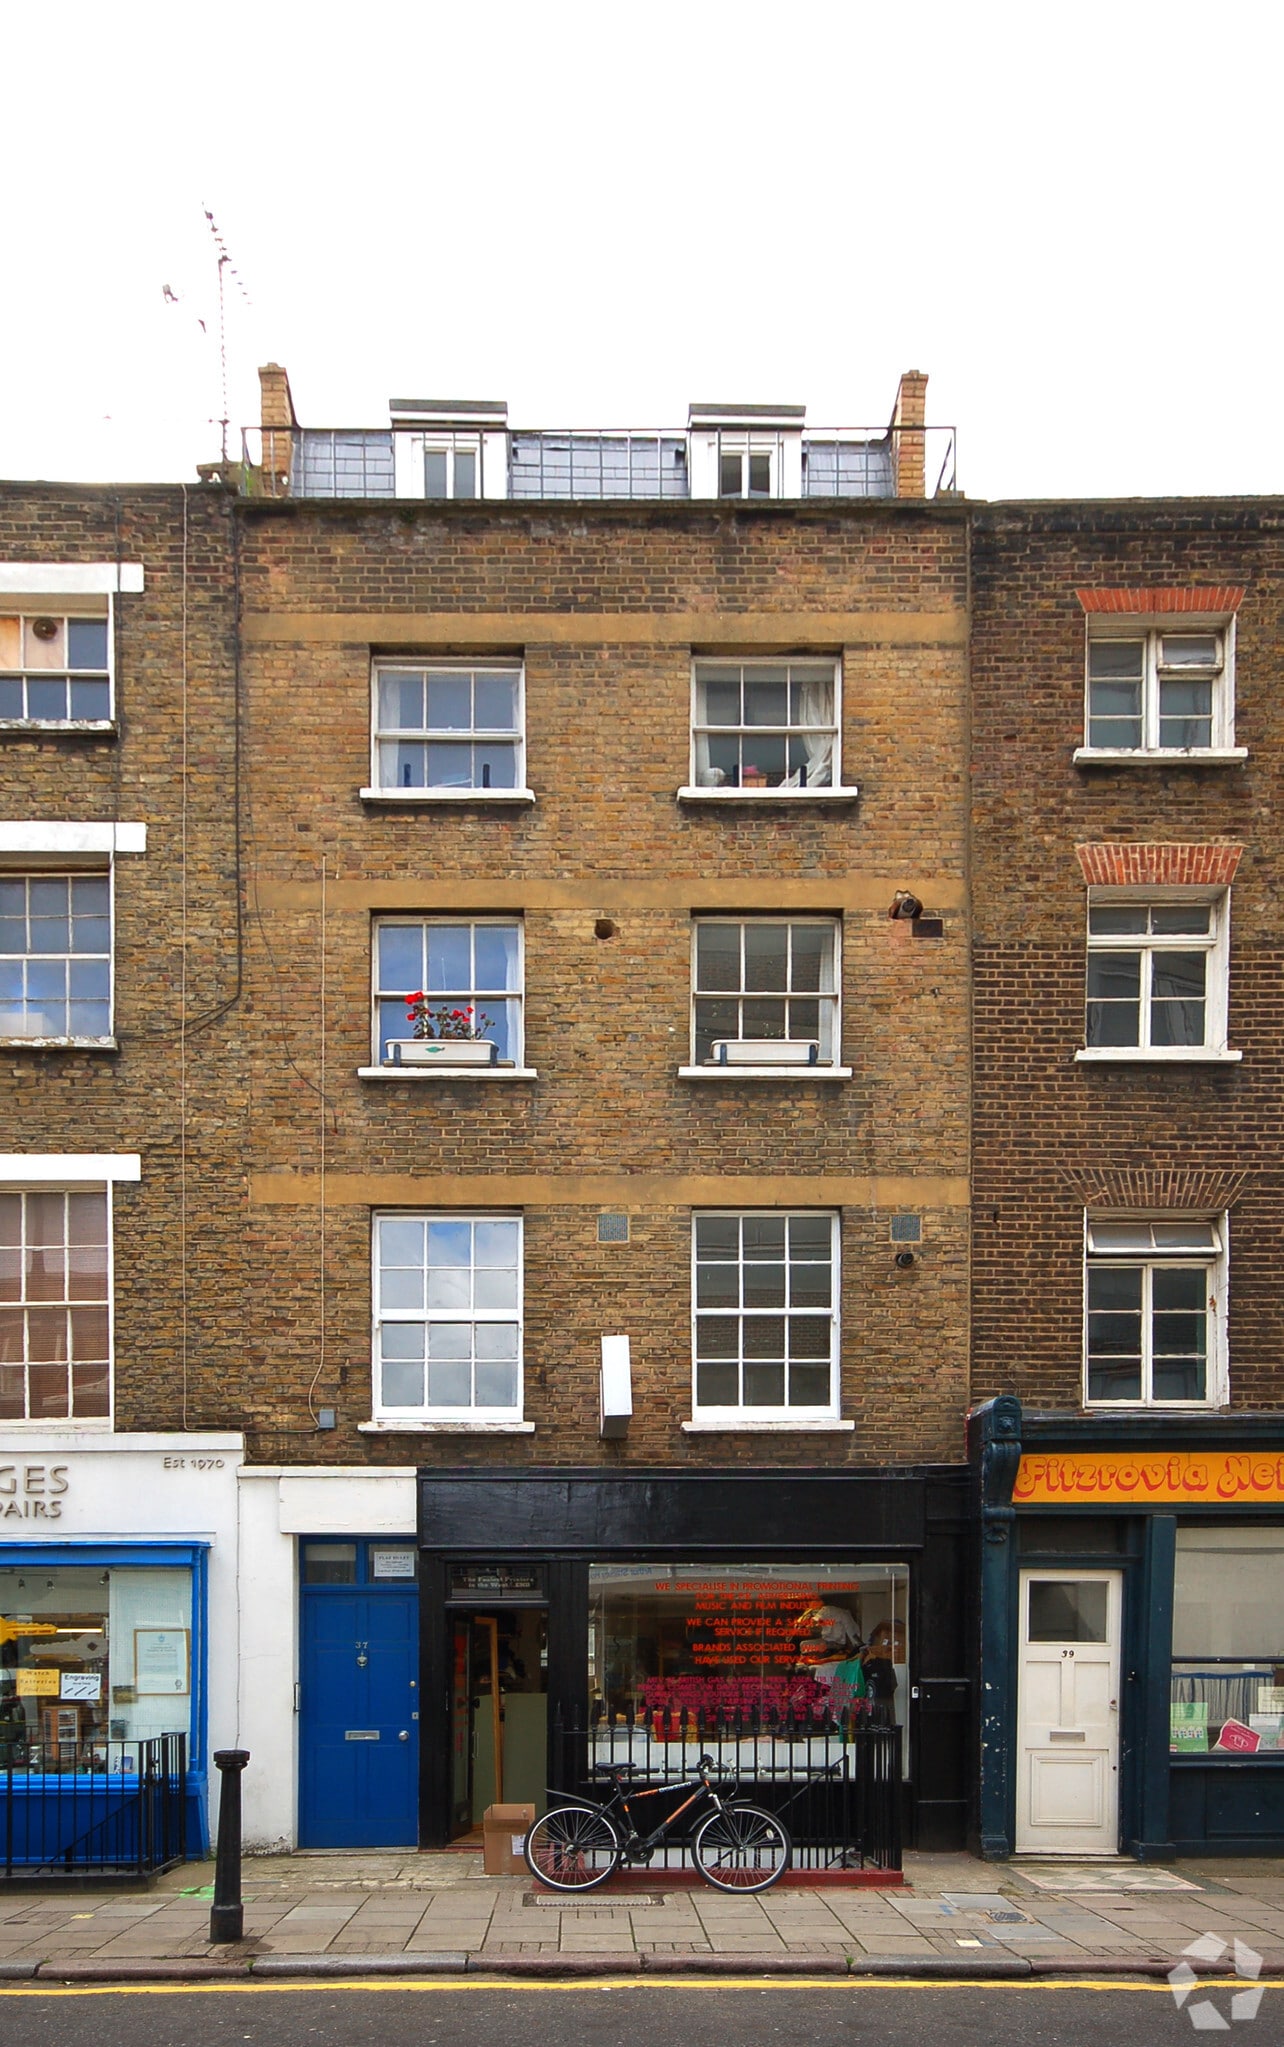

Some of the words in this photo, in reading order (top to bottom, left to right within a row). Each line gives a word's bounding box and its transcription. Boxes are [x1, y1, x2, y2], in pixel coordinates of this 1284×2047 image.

[163, 1457, 185, 1469] Est
[190, 1459, 225, 1470] 1970
[1013, 1456, 1209, 1498] Fitzrovia
[655, 1582, 670, 1591] WE
[675, 1582, 726, 1591] SPECIALISE
[729, 1582, 739, 1591] IN
[742, 1582, 812, 1591] PROMOTIONAL
[816, 1582, 859, 1591] PRINTING
[695, 1602, 726, 1610] MUSIC
[731, 1602, 751, 1610] AND
[755, 1602, 776, 1610] FILM
[687, 1618, 701, 1626] WE
[705, 1618, 728, 1626] CAN
[731, 1618, 771, 1626] PROVIDE
[775, 1618, 782, 1626] A
[714, 1628, 751, 1636] SERVICE
[755, 1628, 763, 1636] IF
[692, 1643, 731, 1652] BRANDS
[736, 1643, 796, 1652] ASSOCIATED
[1061, 1650, 1075, 1658] 39
[750, 1656, 771, 1664] OUR
[64, 1675, 100, 1683] Engraving
